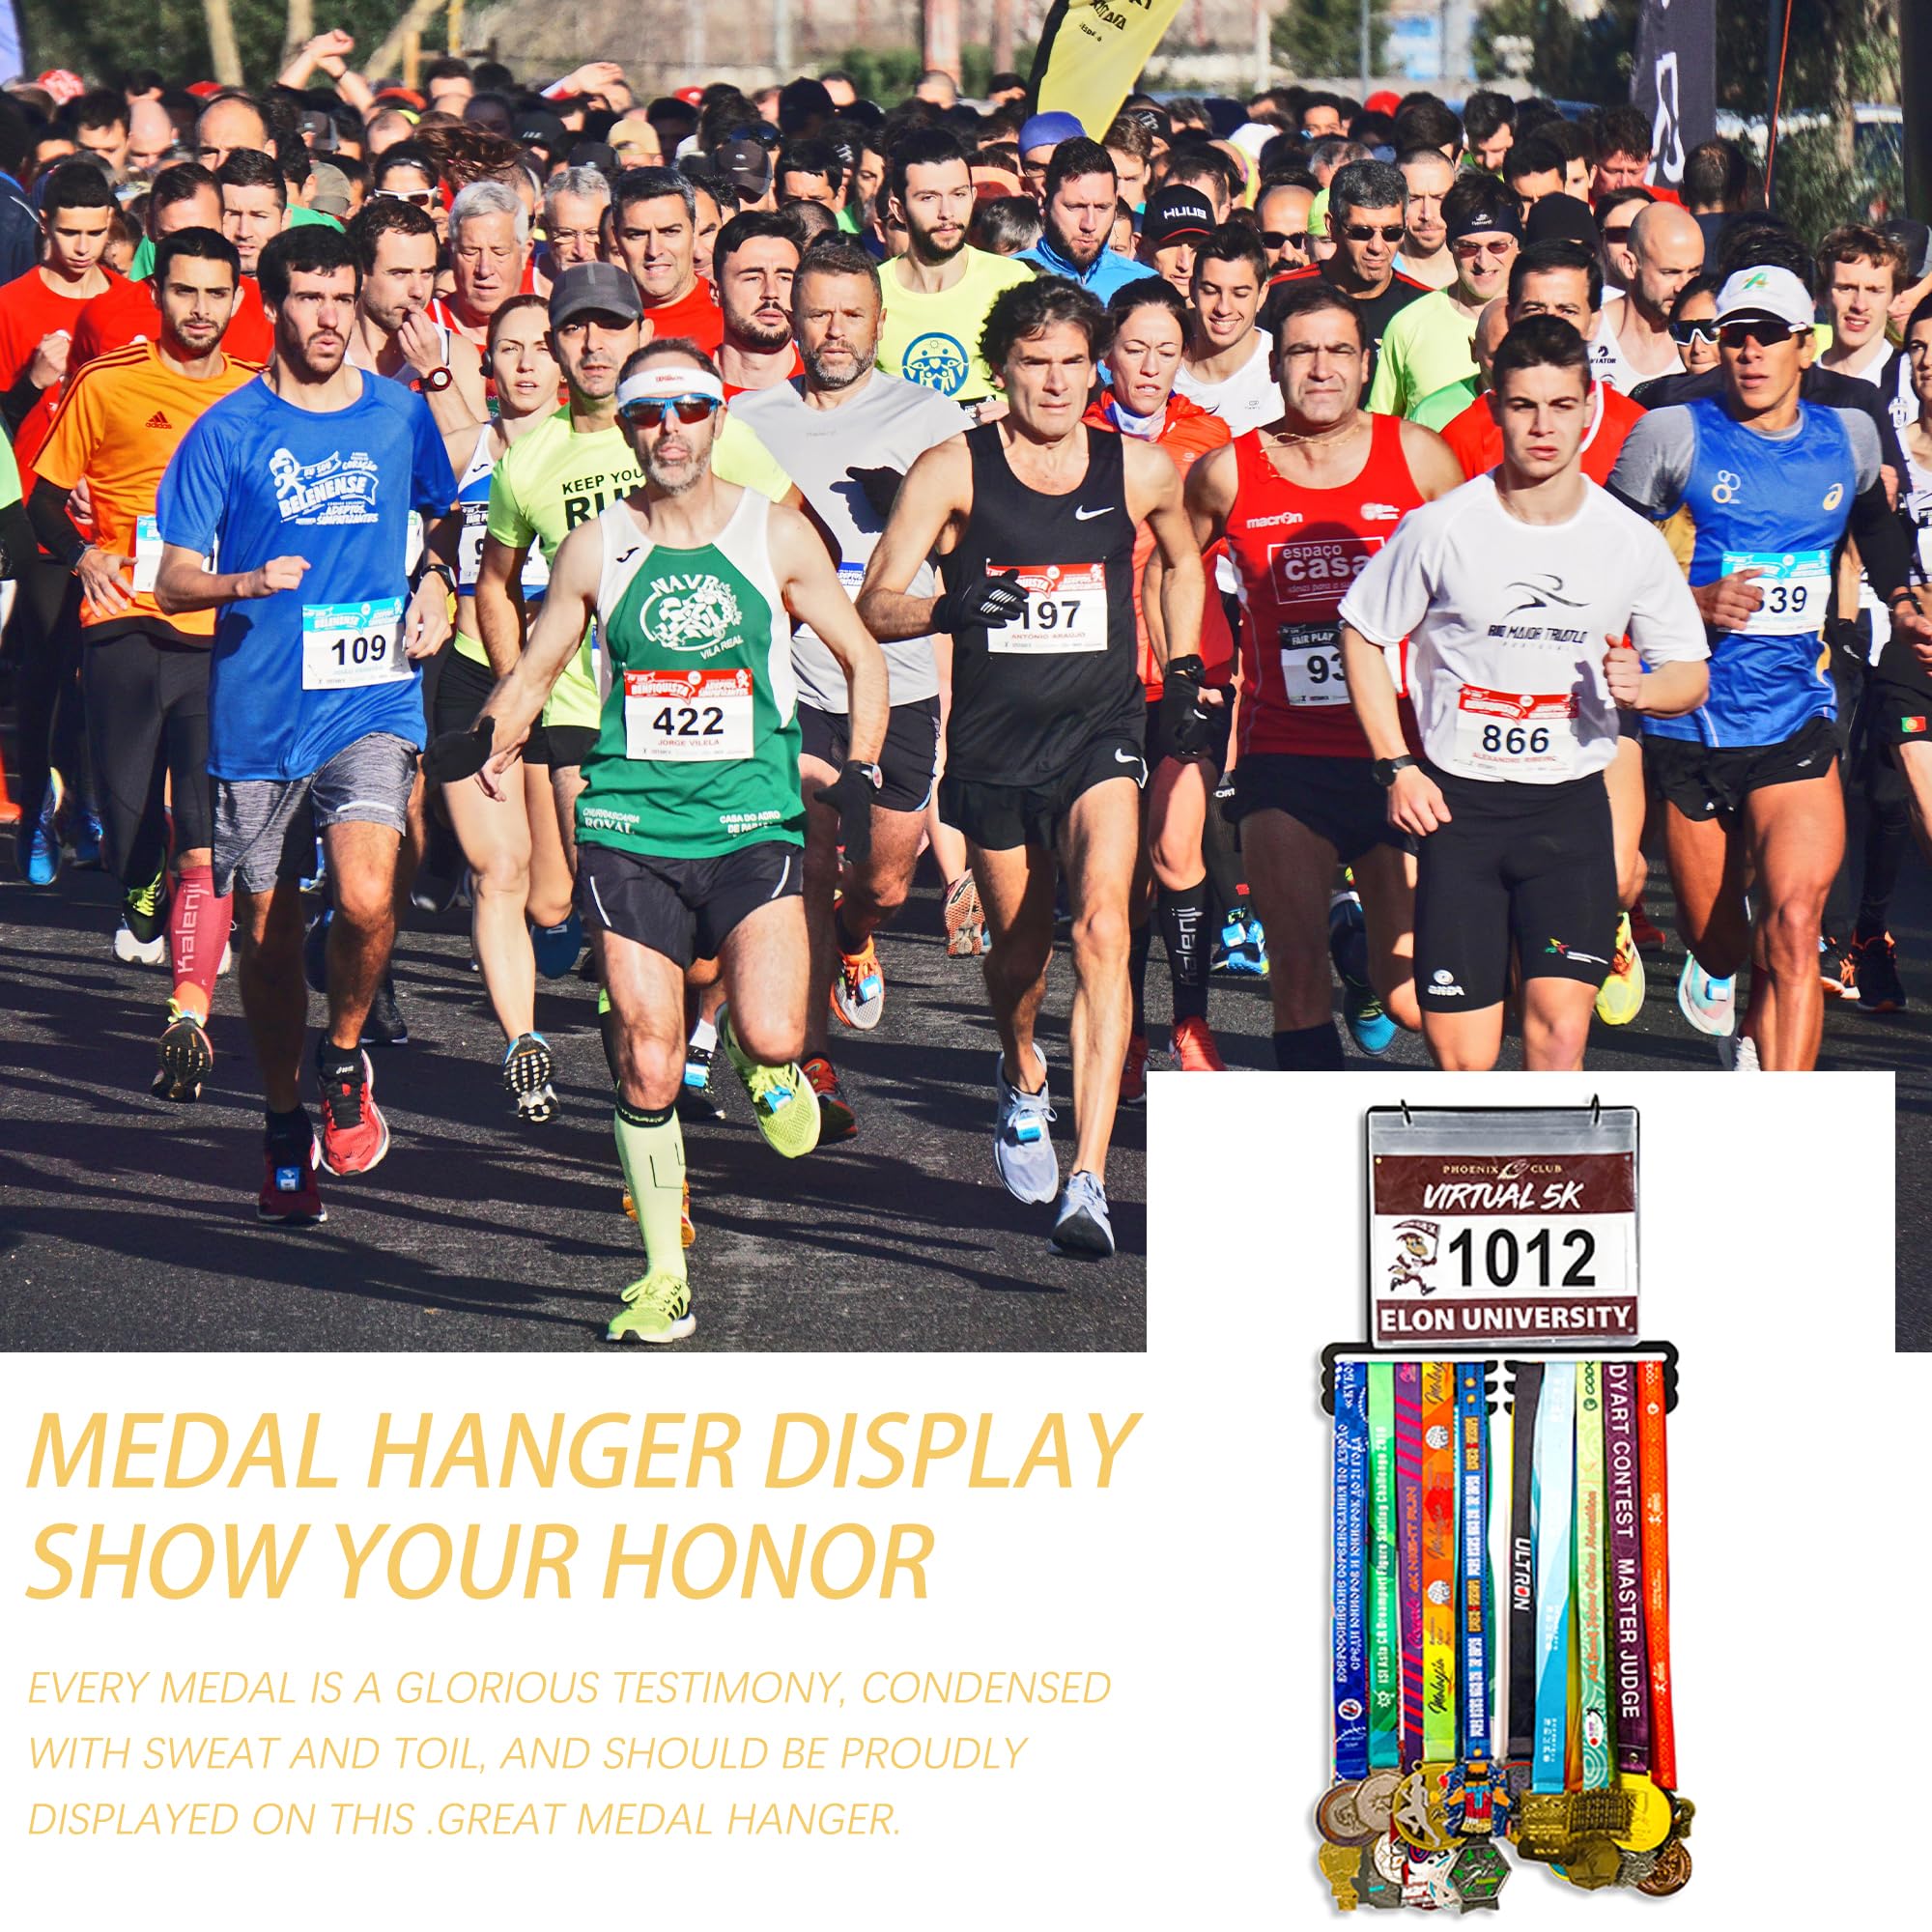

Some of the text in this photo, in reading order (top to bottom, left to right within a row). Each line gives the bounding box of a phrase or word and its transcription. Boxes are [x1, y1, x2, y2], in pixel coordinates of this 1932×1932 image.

[1163, 206, 1208, 220] HUUB
[278, 476, 367, 518] BELENENSE
[562, 474, 605, 495] KEEP
[1246, 512, 1304, 528] macron
[1283, 545, 1343, 560] espaço
[1021, 600, 1081, 630] 197
[331, 635, 386, 666] 109
[700, 635, 745, 660] VILA REAL
[1292, 632, 1334, 644] FAIR PLAY
[652, 707, 724, 736] 422
[1482, 724, 1549, 754] 866
[582, 808, 640, 823] CHURRASCARIA
[719, 814, 742, 824] CASA
[727, 824, 741, 834] DE
[1442, 1164, 1563, 1175] PHOENIX CLUB
[1423, 1180, 1585, 1210] VIRTUAL 5K
[1448, 1228, 1596, 1288] 1012
[1380, 1305, 1632, 1332] ELON UNIVERSITY
[1612, 1442, 1634, 1539] CONTEST
[1514, 1538, 1532, 1611] ULTRON
[1617, 1558, 1640, 1719] MASTER JUDGE
[1427, 1658, 1450, 1714] Malaysia
